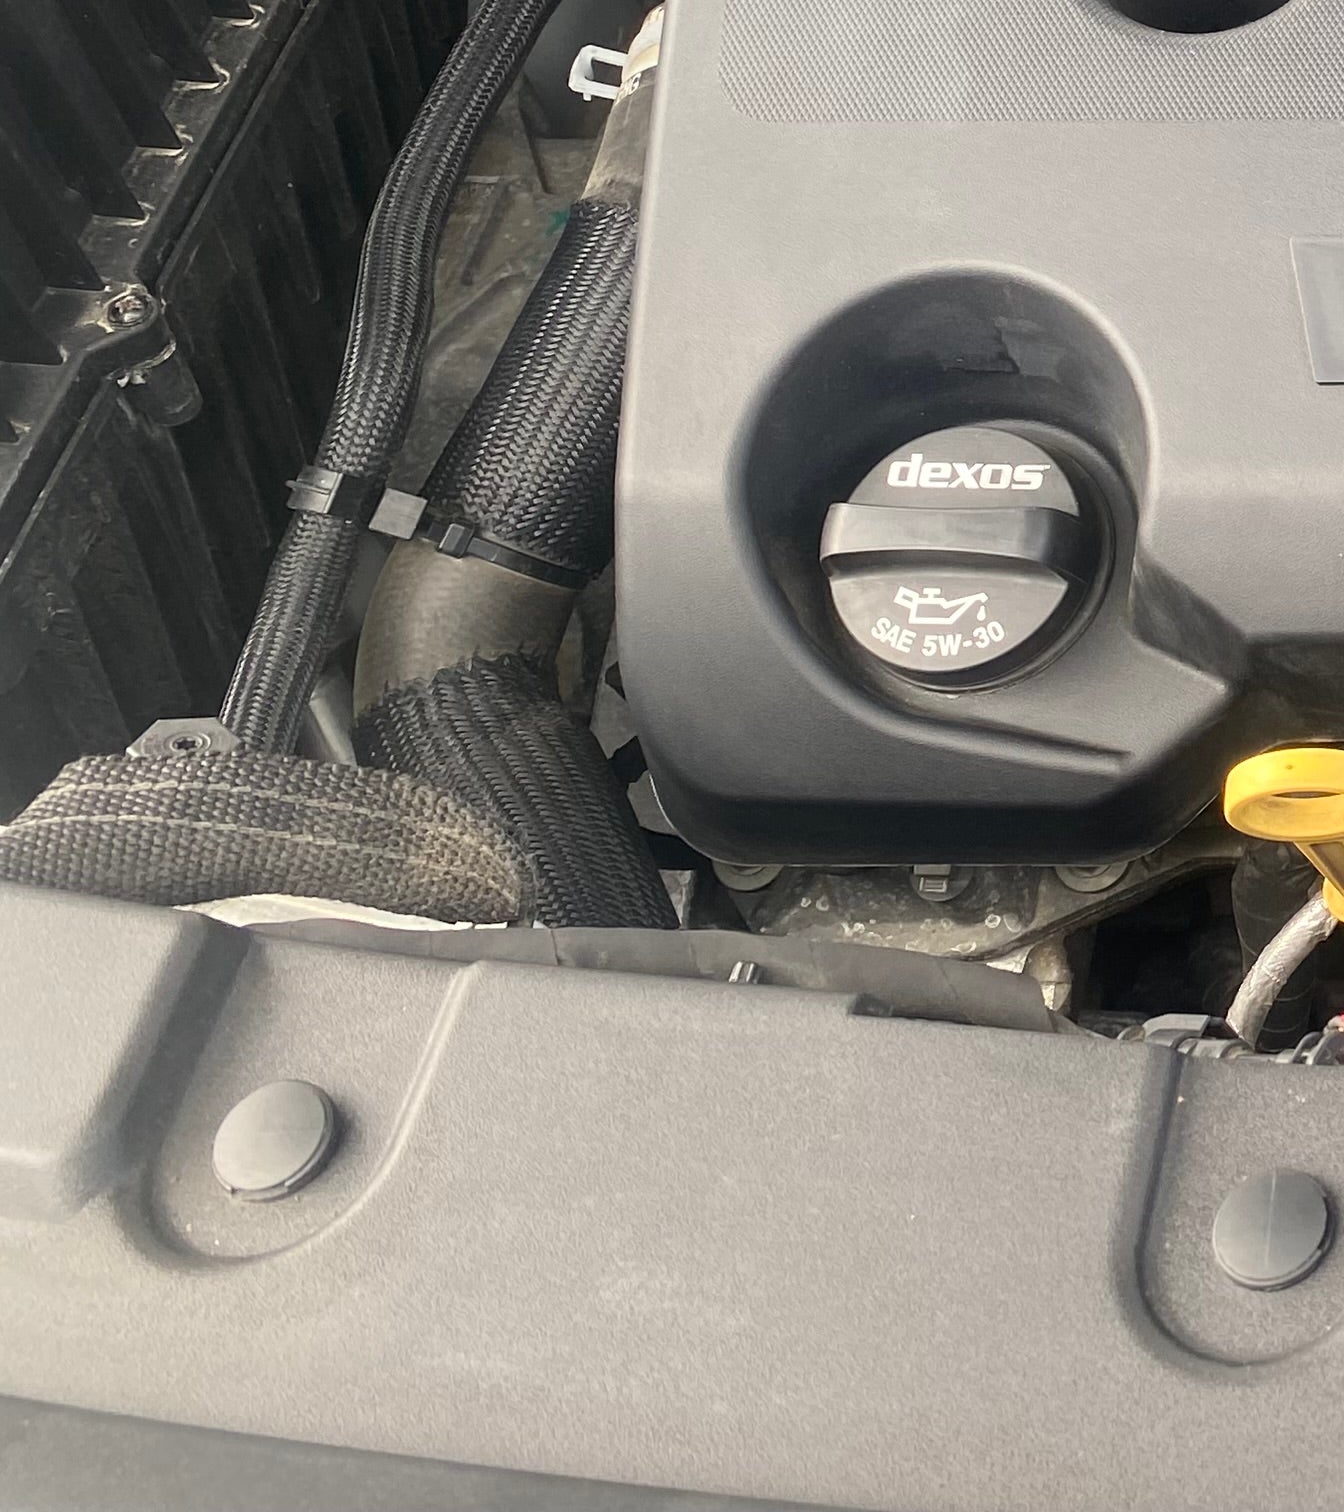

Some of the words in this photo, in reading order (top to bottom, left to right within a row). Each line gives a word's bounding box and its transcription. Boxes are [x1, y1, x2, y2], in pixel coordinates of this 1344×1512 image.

[887, 453, 1046, 491] dexos
[871, 617, 917, 654] SAE
[921, 620, 1006, 657] 5W-30
